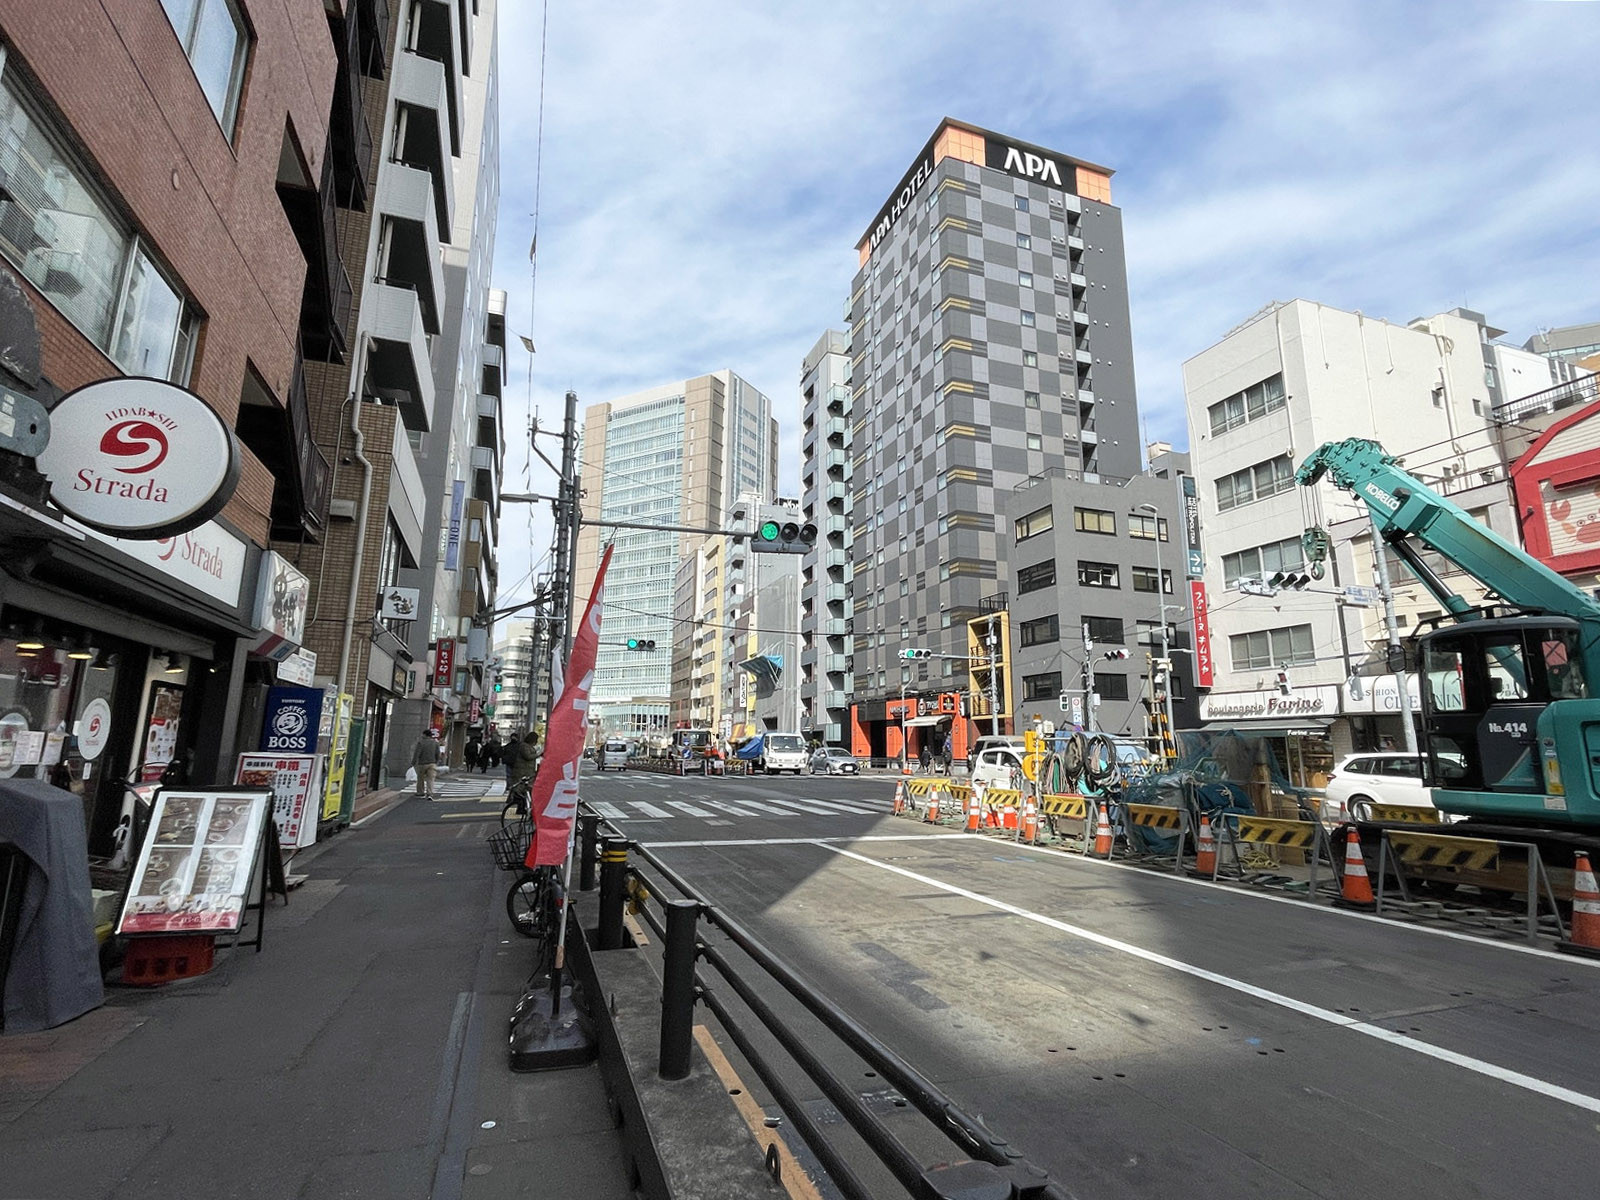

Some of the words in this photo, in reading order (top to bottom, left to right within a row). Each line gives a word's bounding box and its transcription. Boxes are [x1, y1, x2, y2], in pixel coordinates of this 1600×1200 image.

[1003, 146, 1063, 186] APA
[869, 214, 892, 254] APA
[892, 159, 933, 223] HOTEL
[73, 468, 169, 503] Strada
[1364, 482, 1401, 511] KOBELCO
[181, 531, 223, 580] Strada
[276, 705, 307, 717] COFFEE
[1207, 701, 1265, 715] boulangerie
[1267, 697, 1324, 712] Farine
[267, 736, 307, 749] BOSS
